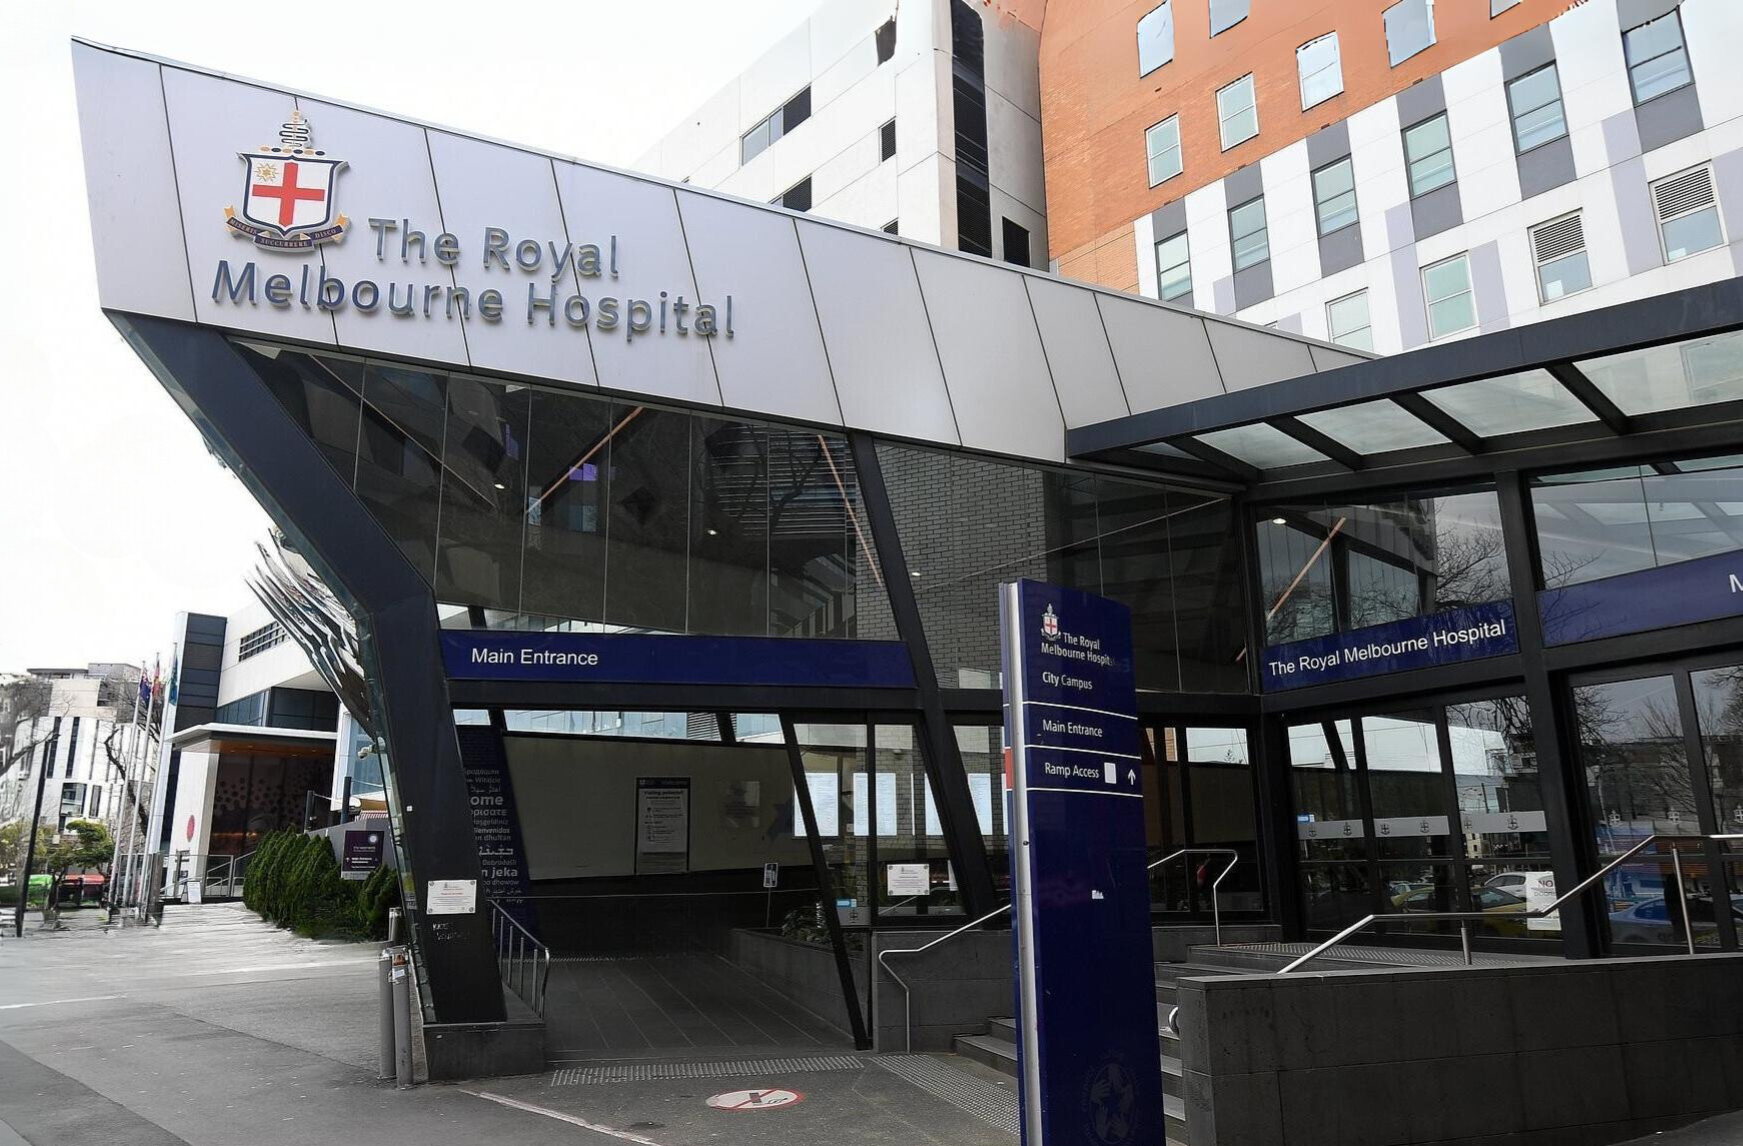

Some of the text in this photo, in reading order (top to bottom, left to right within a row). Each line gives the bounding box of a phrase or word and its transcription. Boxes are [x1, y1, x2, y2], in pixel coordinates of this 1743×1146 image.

[315, 228, 337, 239] DISCO
[368, 217, 619, 281] The Royal
[211, 260, 735, 342] Melbourne Hospital
[1062, 632, 1100, 651] The Royal
[1268, 619, 1506, 677] The Royal Melbourne Hospital
[471, 648, 599, 665] Main Entrance
[1041, 642, 1115, 667] Melbourne Hospit
[1042, 671, 1093, 690] City Campus
[1042, 719, 1103, 738] Main Entrance
[1044, 762, 1100, 779] Ramp Access
[1538, 880, 1553, 888] NO
